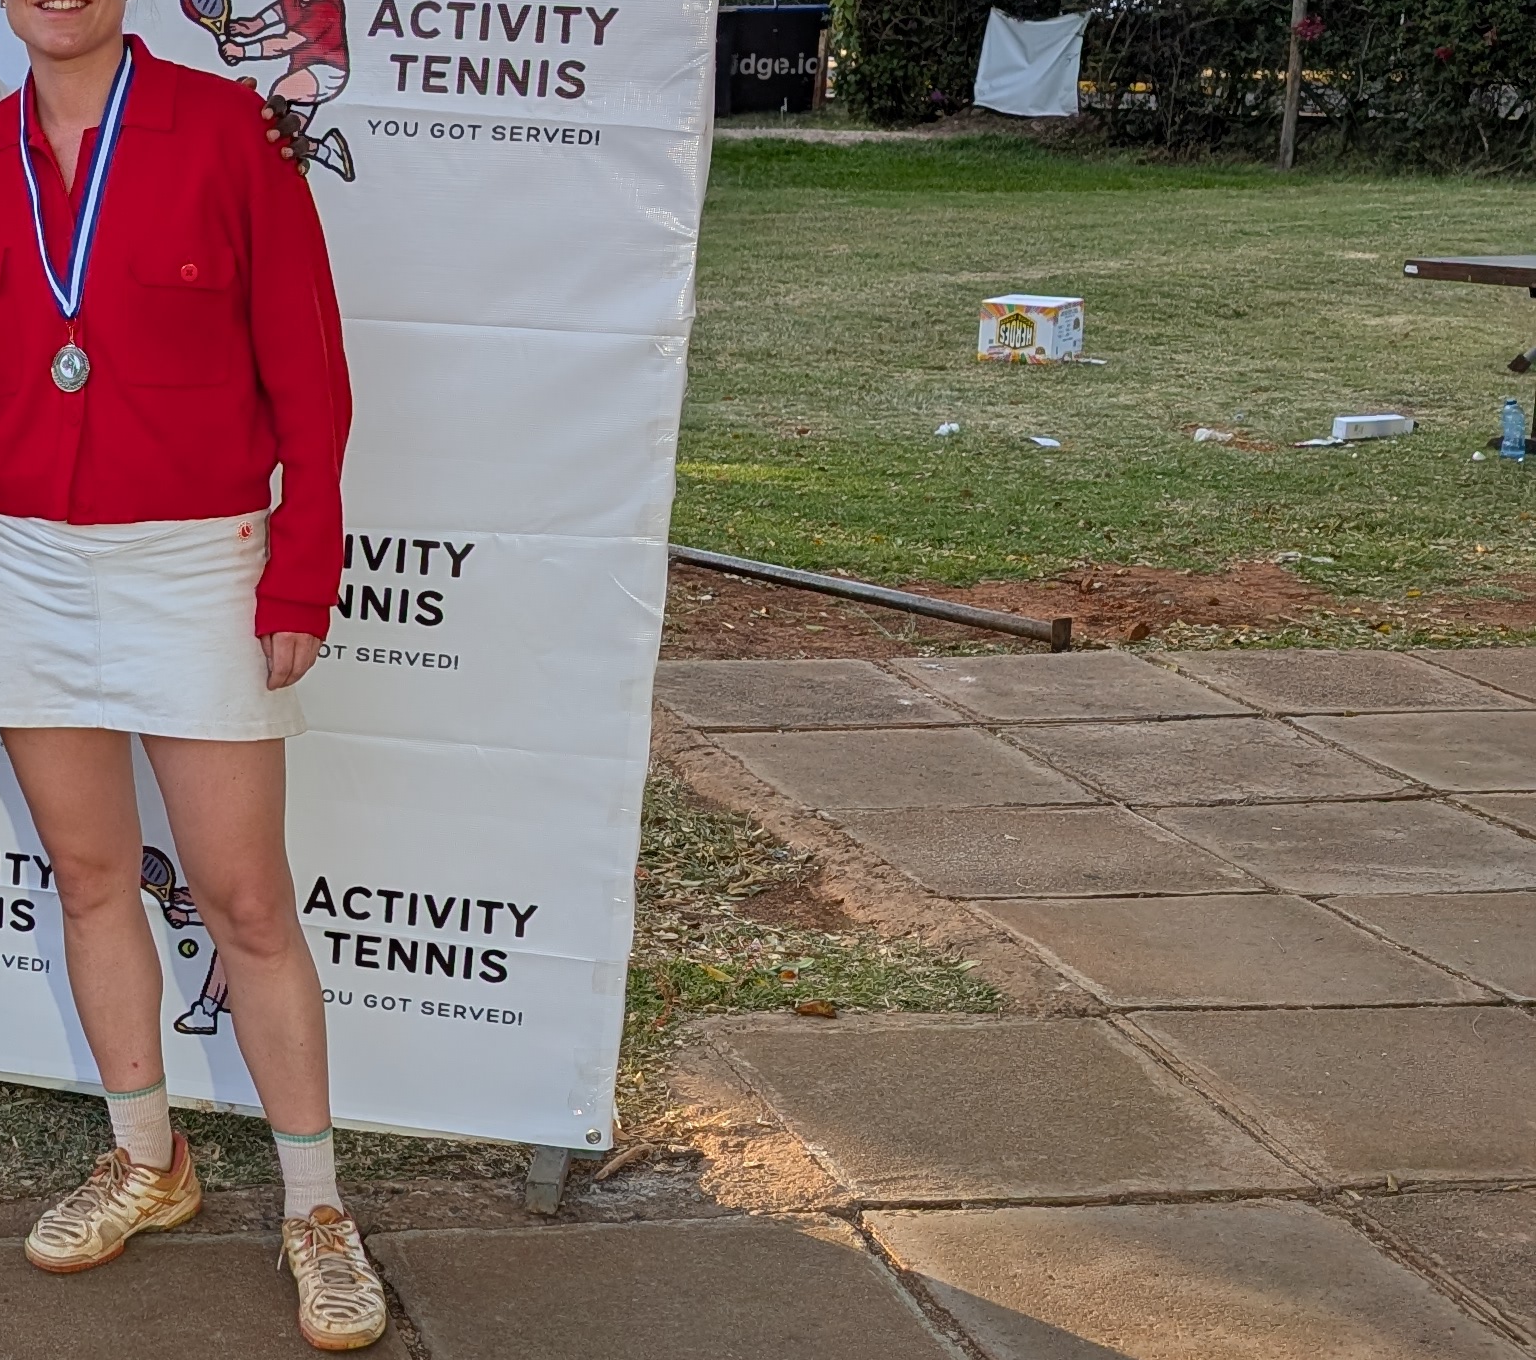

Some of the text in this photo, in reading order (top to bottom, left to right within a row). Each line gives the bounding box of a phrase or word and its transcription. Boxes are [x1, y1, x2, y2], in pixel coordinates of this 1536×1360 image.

[389, 53, 586, 100] TENNIS
[367, 119, 601, 146] YOU GOT SERVED!
[999, 320, 1033, 348] HEROES
[343, 533, 476, 578] IVITY
[337, 584, 444, 627] NNIS
[317, 643, 459, 670] OT SERVED!
[302, 875, 539, 938] ACTIVITY
[323, 930, 508, 984] TENNIS
[321, 988, 524, 1026] OU GOT SERVED!
